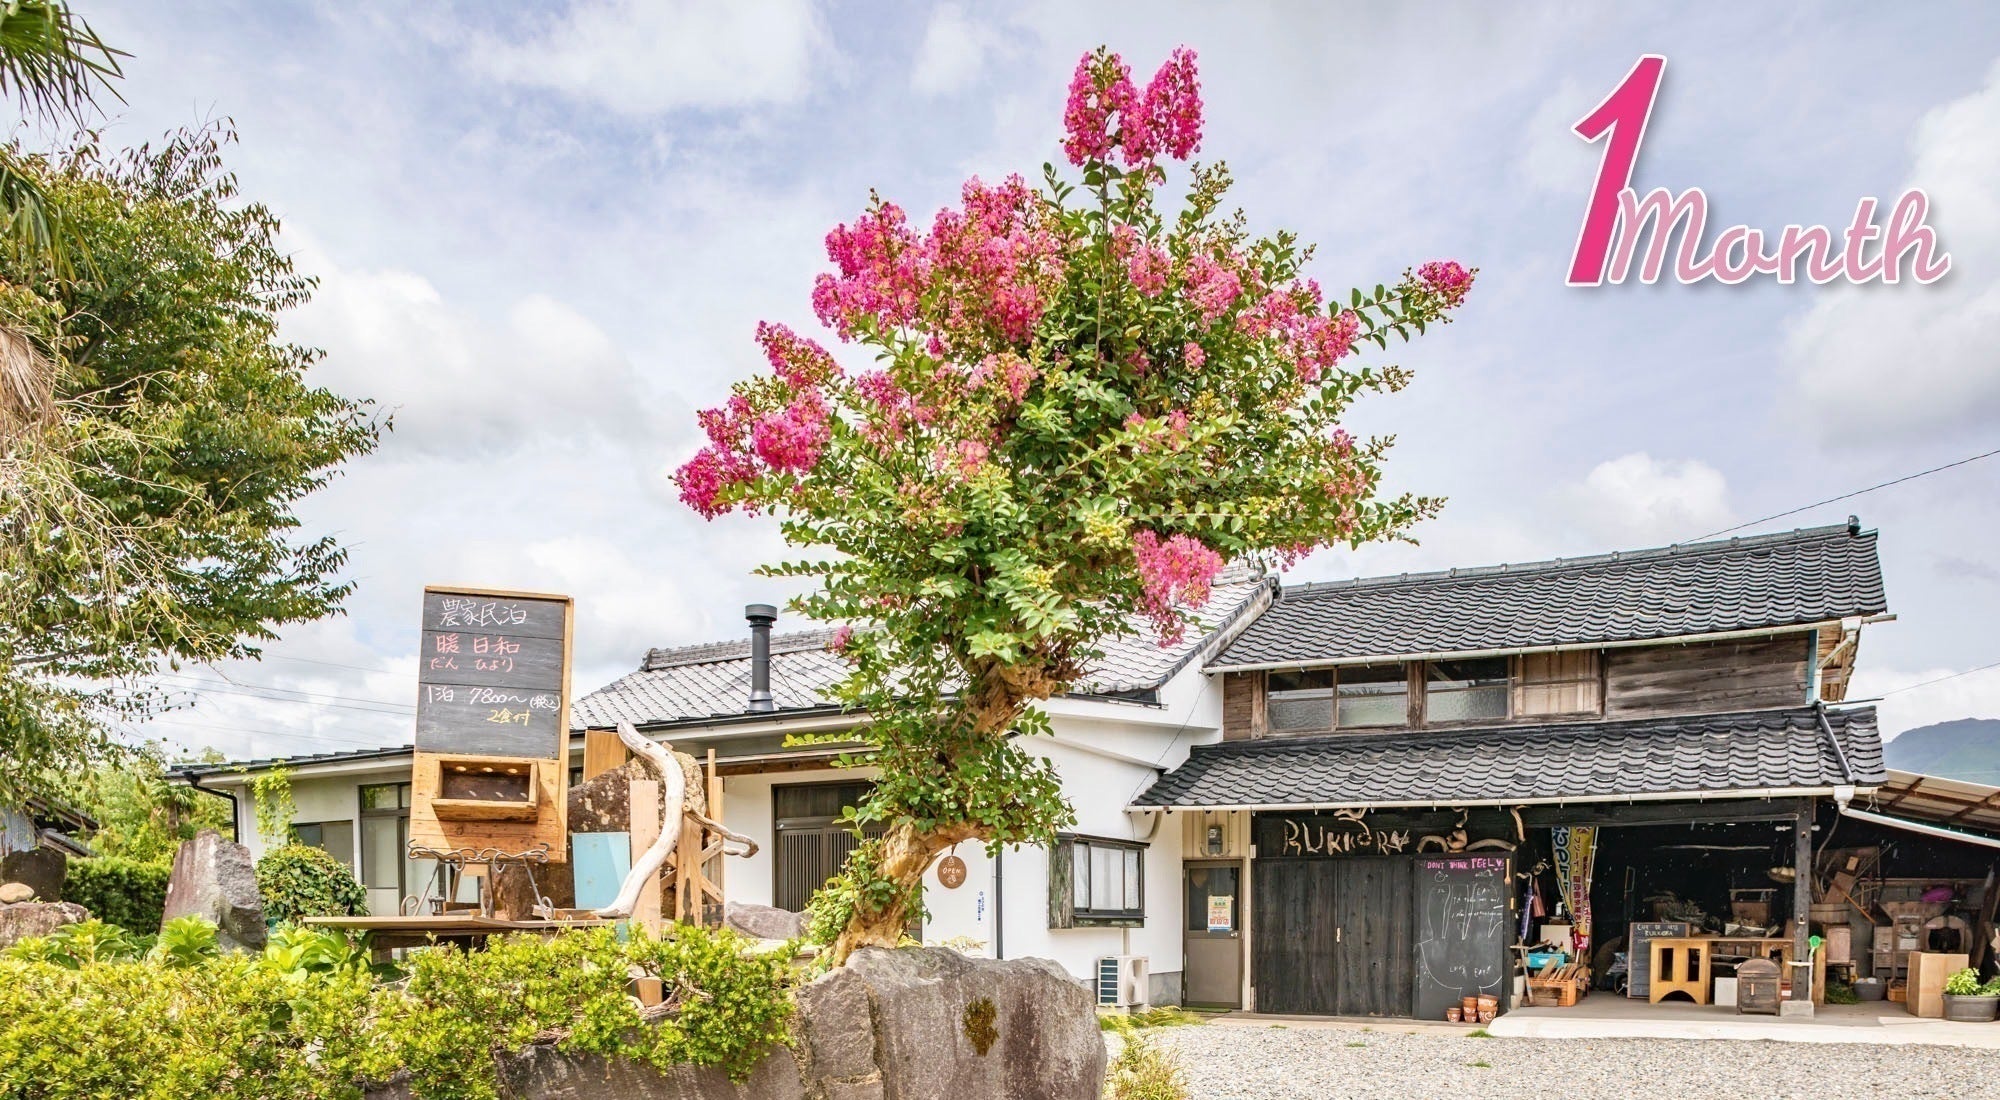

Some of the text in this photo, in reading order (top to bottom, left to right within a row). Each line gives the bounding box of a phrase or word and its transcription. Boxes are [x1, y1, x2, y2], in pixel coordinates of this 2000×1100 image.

[440, 599, 527, 627] 農家民泊
[436, 633, 521, 656] 暖 日和
[430, 656, 514, 673] だん ひより
[427, 685, 454, 704] 1泊
